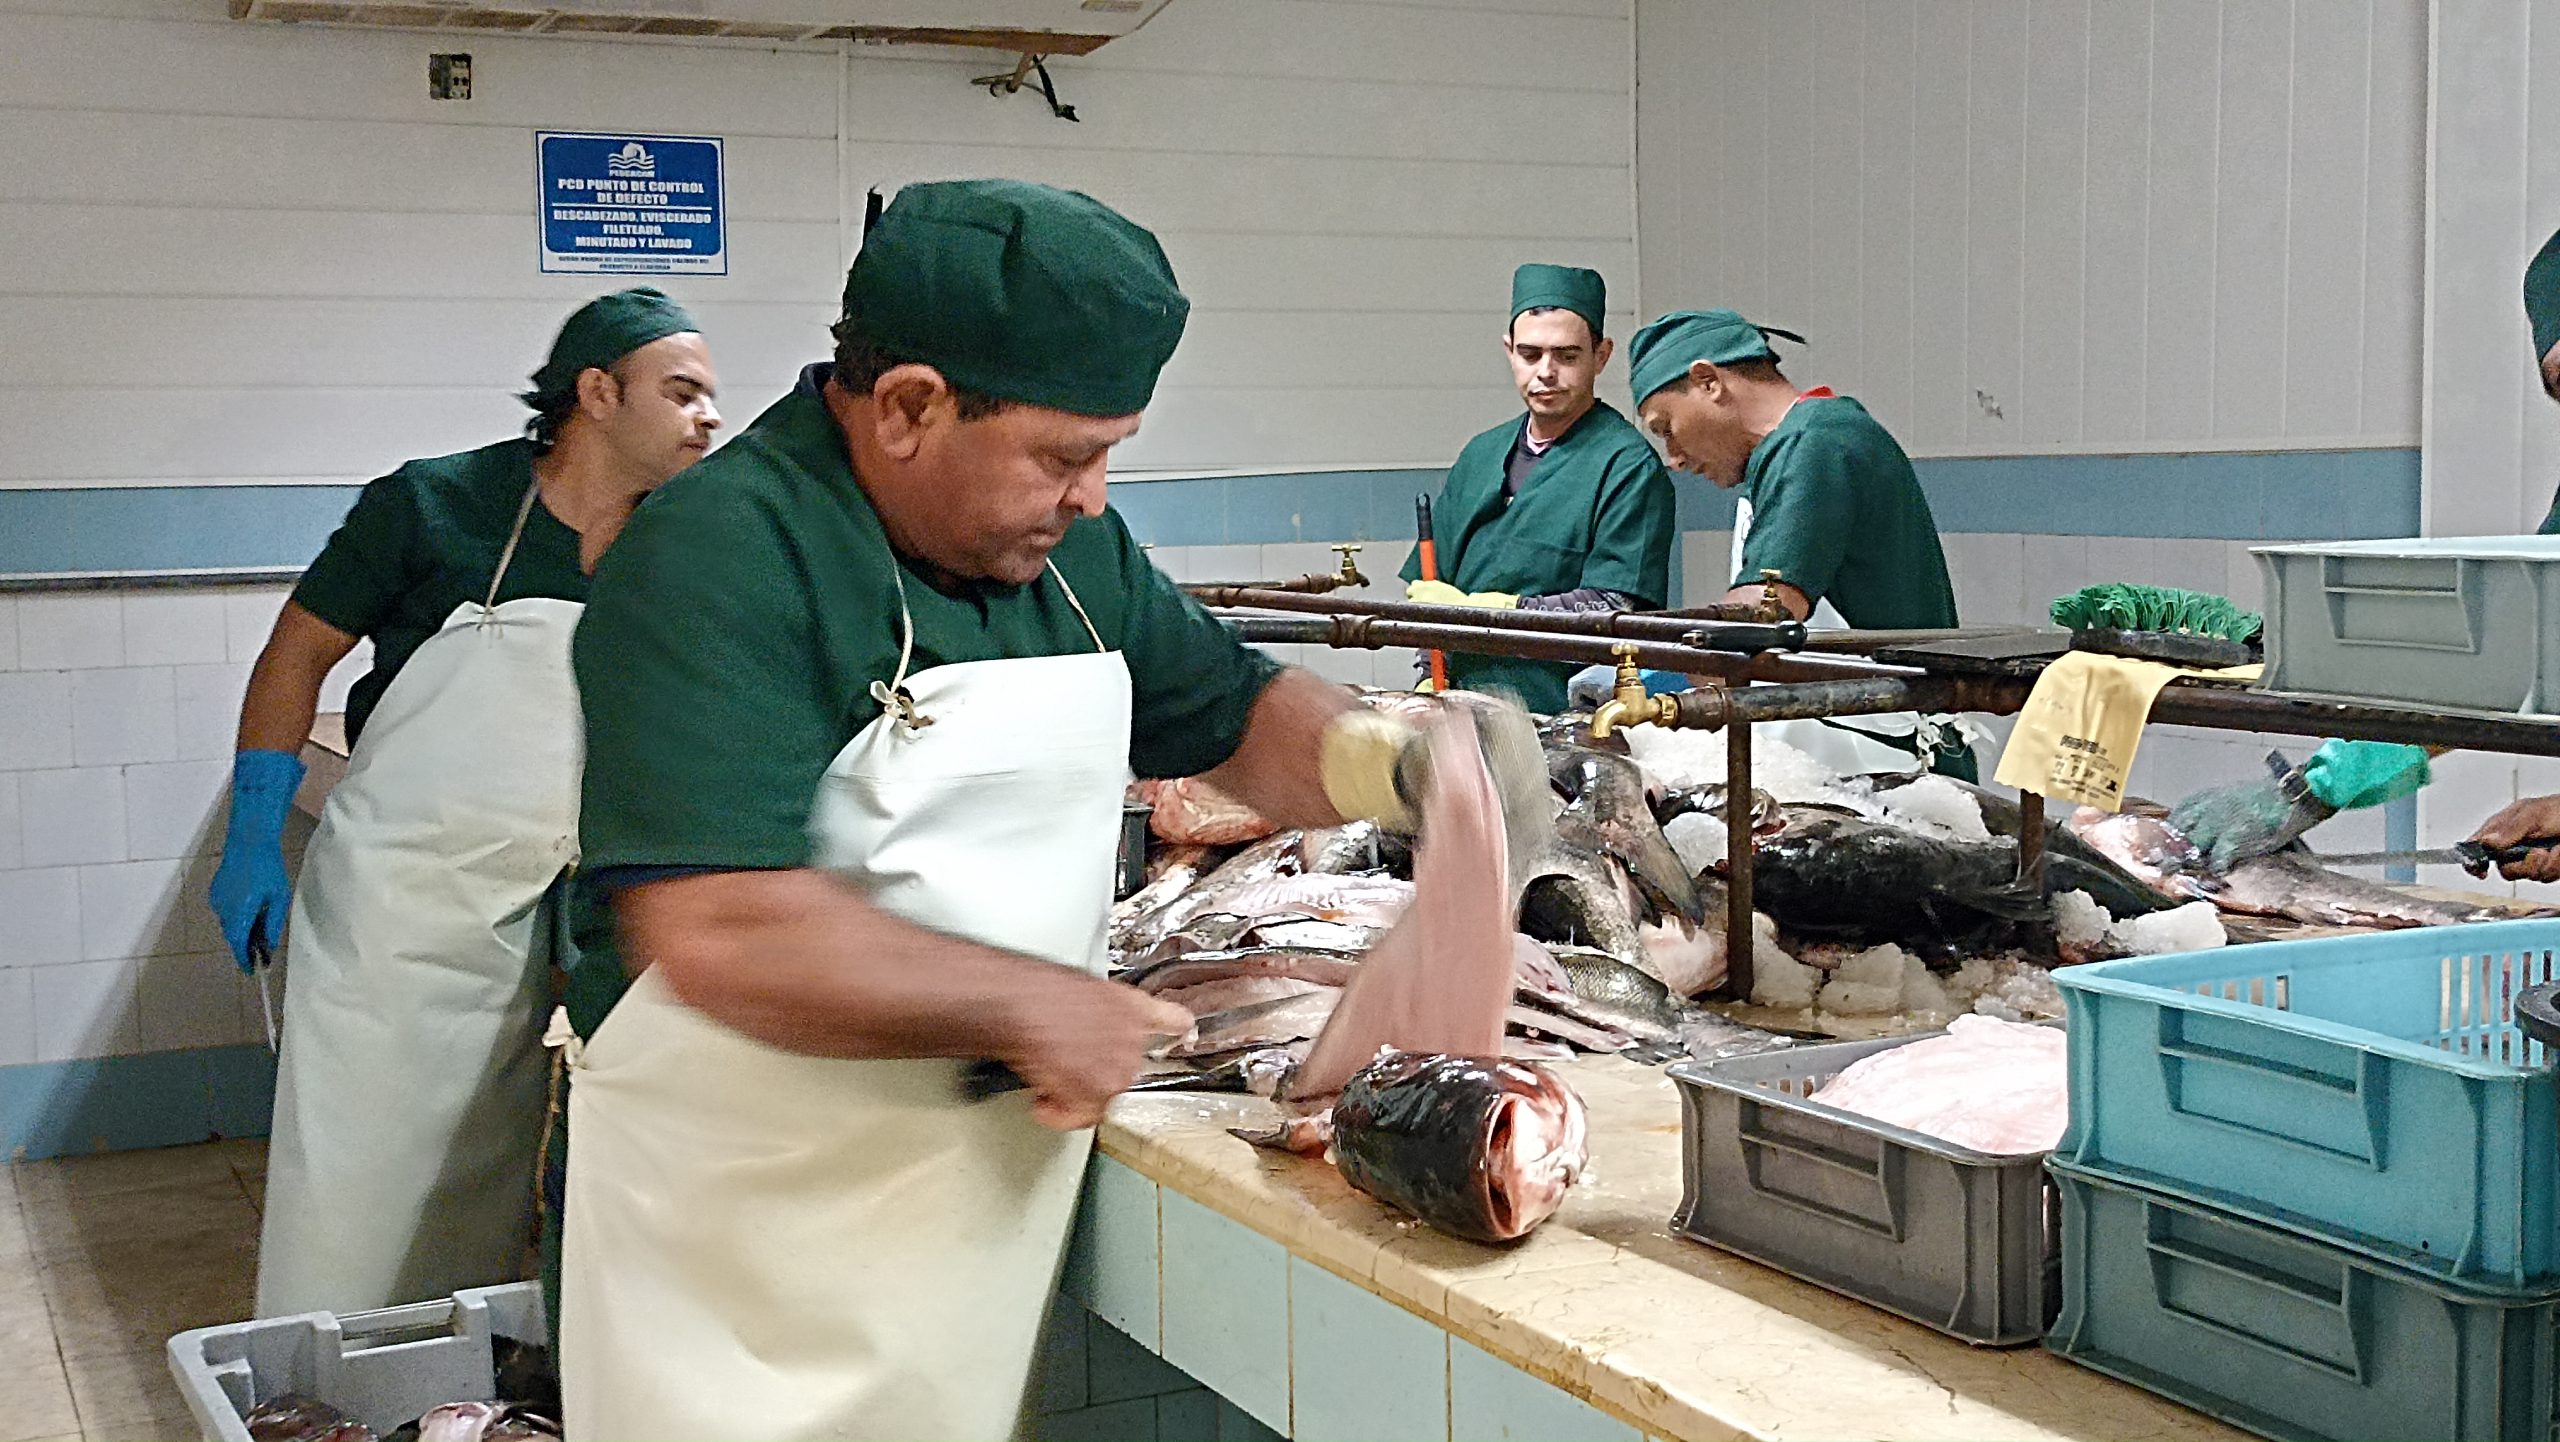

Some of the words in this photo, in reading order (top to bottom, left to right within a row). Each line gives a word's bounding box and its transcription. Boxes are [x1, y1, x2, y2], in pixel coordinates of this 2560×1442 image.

[587, 179, 628, 191] PUNTO
[631, 180, 646, 192] DE
[649, 181, 705, 193] CONTROL
[597, 193, 613, 204] DE
[615, 193, 668, 205] DEFECTO
[641, 212, 712, 224] EVISCERADO
[576, 236, 637, 248] MINUTADO
[639, 237, 648, 248] Y
[649, 238, 692, 250] LAVADO
